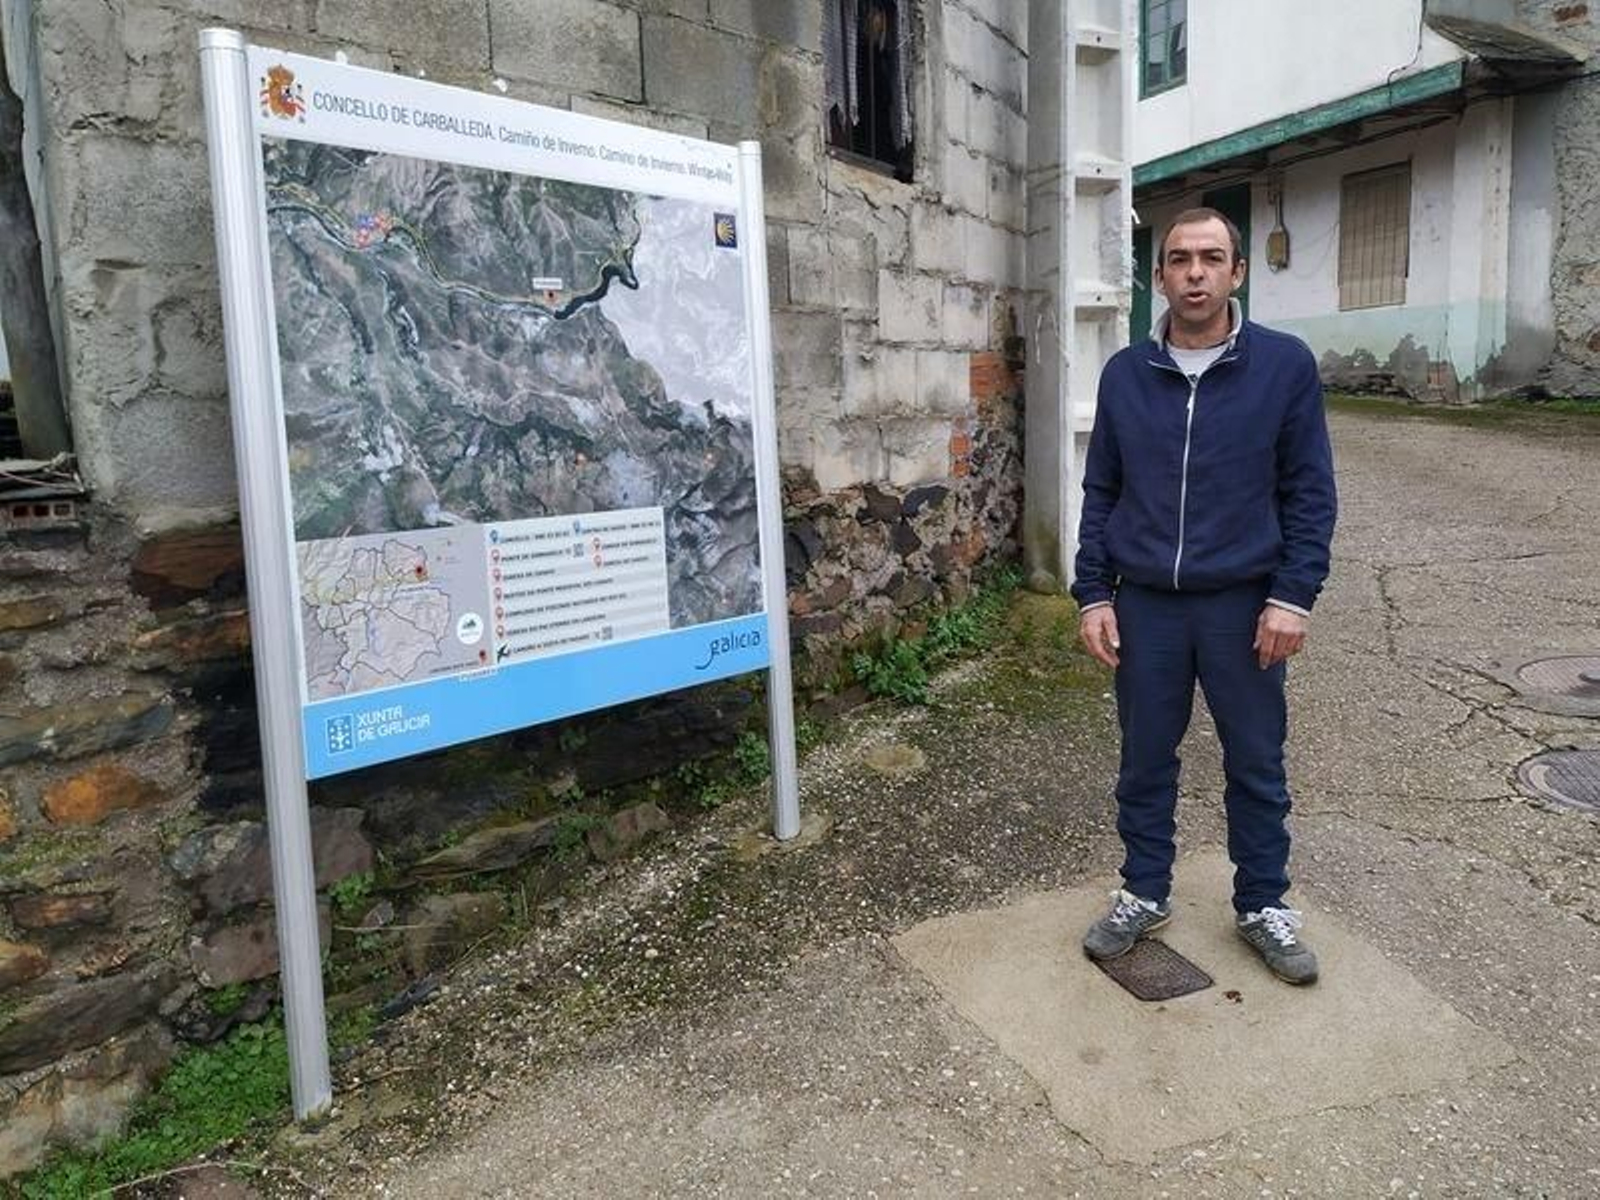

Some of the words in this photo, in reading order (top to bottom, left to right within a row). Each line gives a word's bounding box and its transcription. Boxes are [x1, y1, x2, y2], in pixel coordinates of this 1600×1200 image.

[312, 91, 388, 120] CONCELLO
[392, 106, 409, 125] DE
[413, 110, 496, 140] CARBALLEDA.
[499, 127, 540, 149] Camiño
[543, 134, 555, 151] de
[694, 630, 760, 670] galicia
[357, 705, 403, 727] XUNTA
[358, 726, 376, 743] DE
[377, 714, 431, 739] GALICIA
